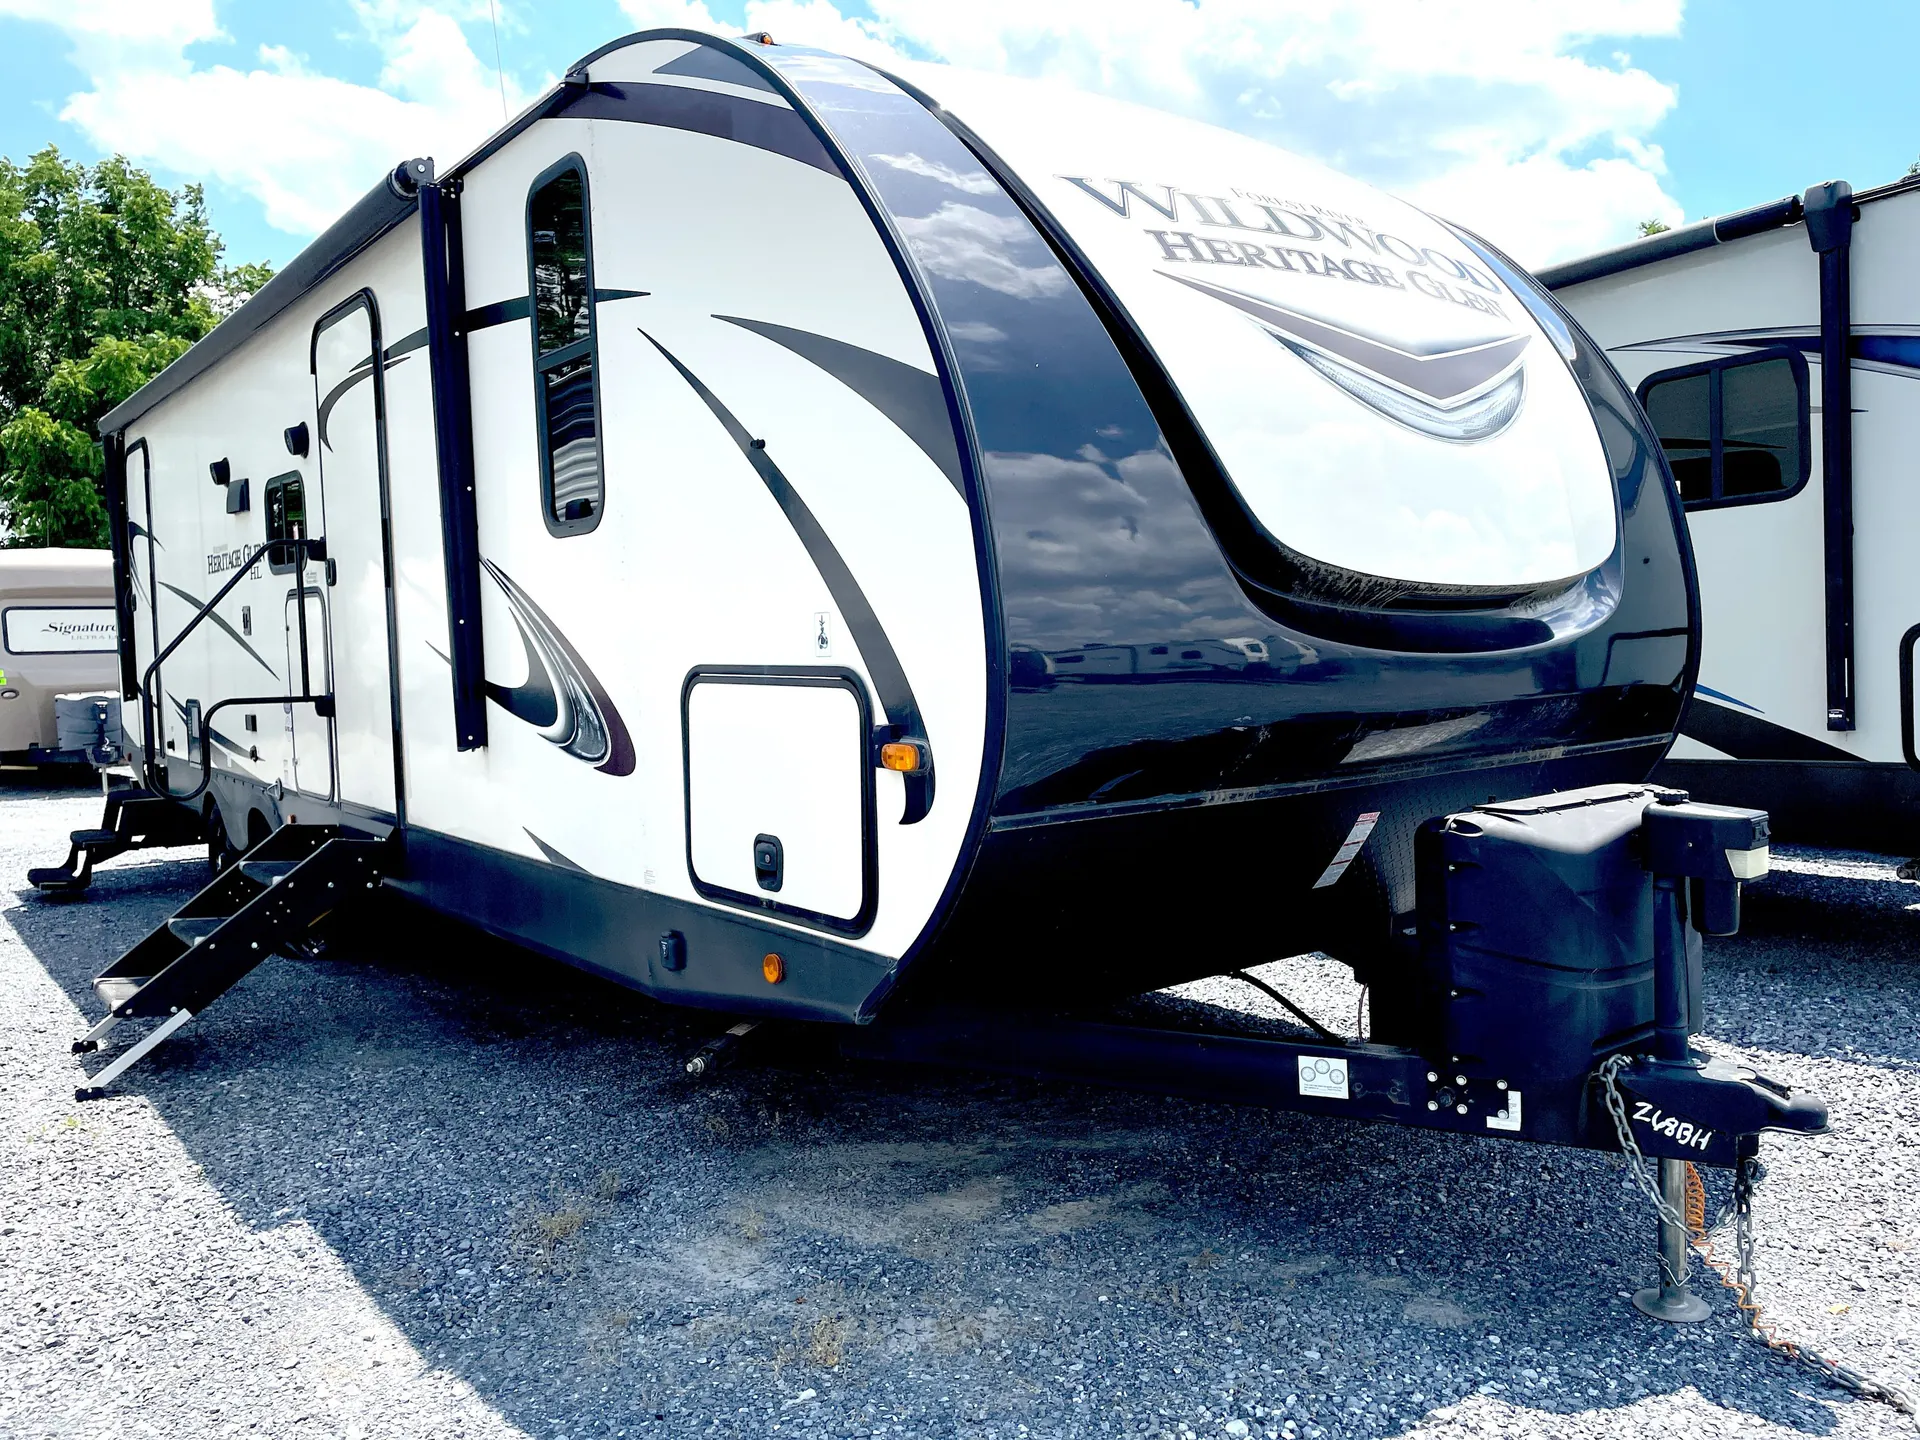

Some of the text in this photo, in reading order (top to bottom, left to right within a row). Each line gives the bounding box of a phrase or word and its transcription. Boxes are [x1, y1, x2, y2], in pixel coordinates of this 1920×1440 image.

[1053, 174, 1503, 294] WILDWOOD
[1143, 228, 1513, 324] HERITAGE GLEN
[207, 548, 242, 575] HERITAGE
